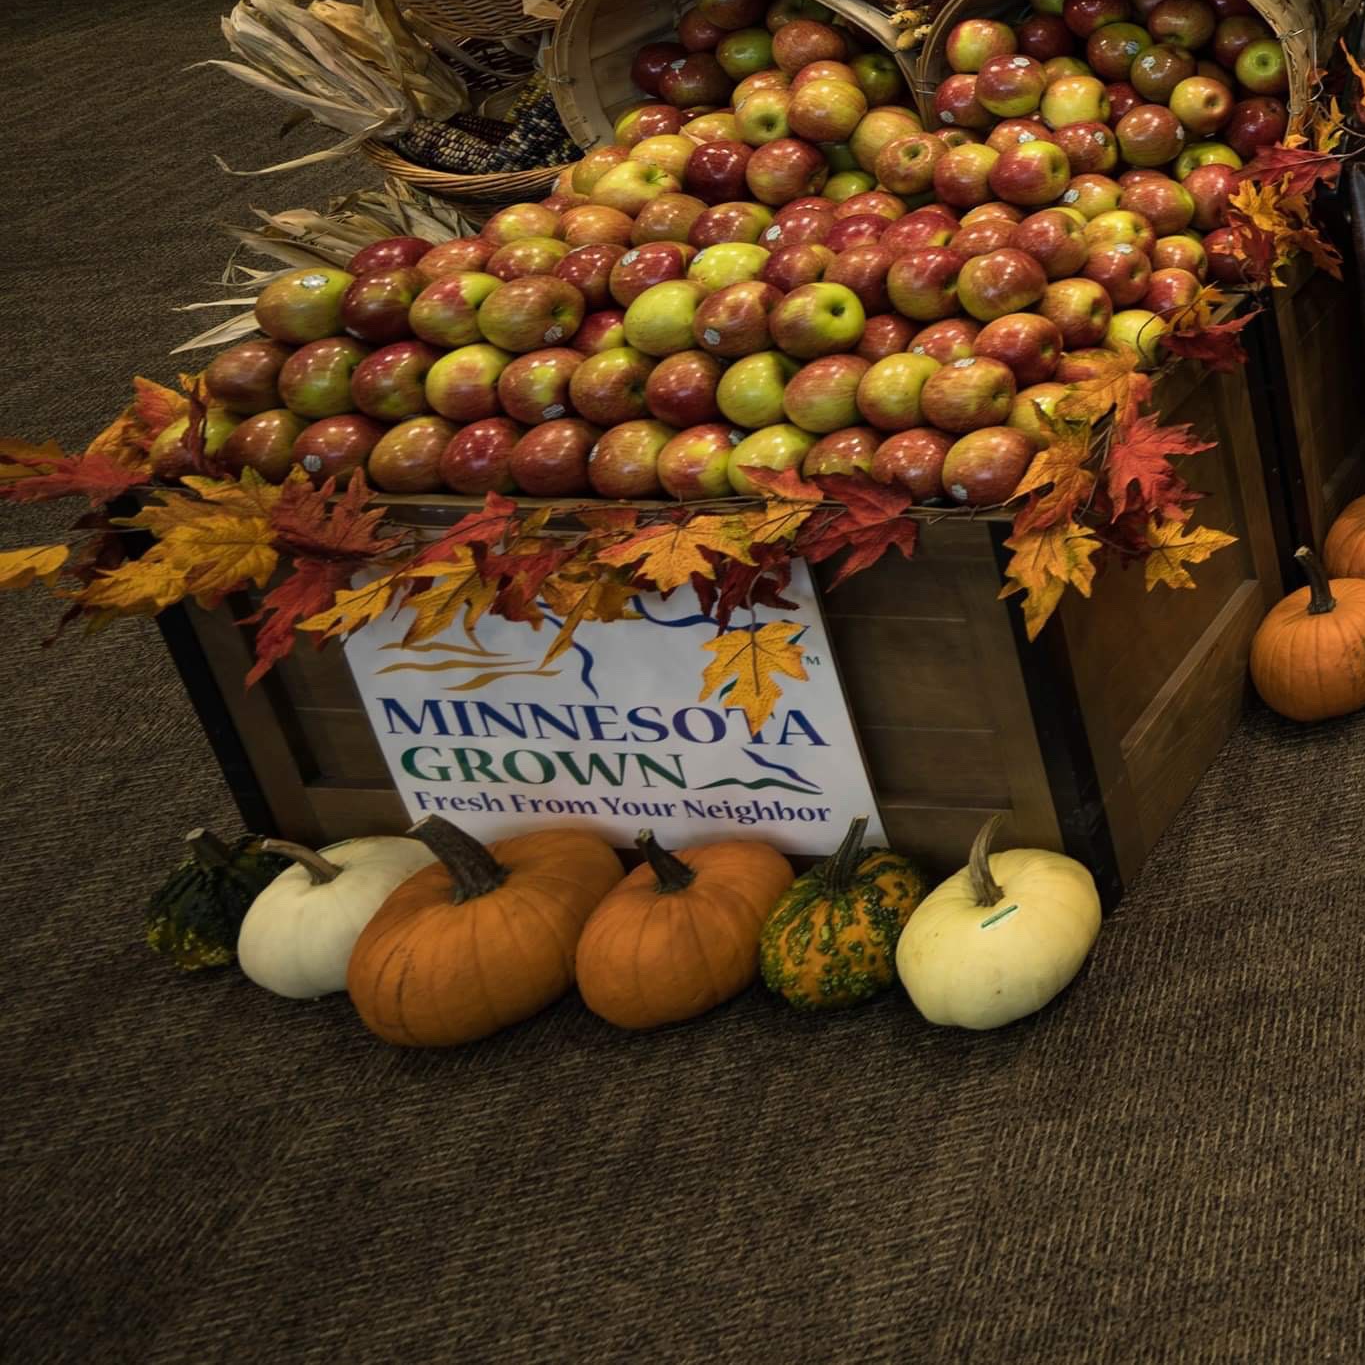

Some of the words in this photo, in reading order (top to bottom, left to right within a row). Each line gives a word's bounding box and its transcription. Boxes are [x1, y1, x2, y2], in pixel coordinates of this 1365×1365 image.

[400, 745, 690, 791] GROWN
[412, 790, 505, 814] Fresh
[509, 793, 601, 816] From
[601, 795, 677, 820] Your
[681, 799, 833, 826] Neighbor
